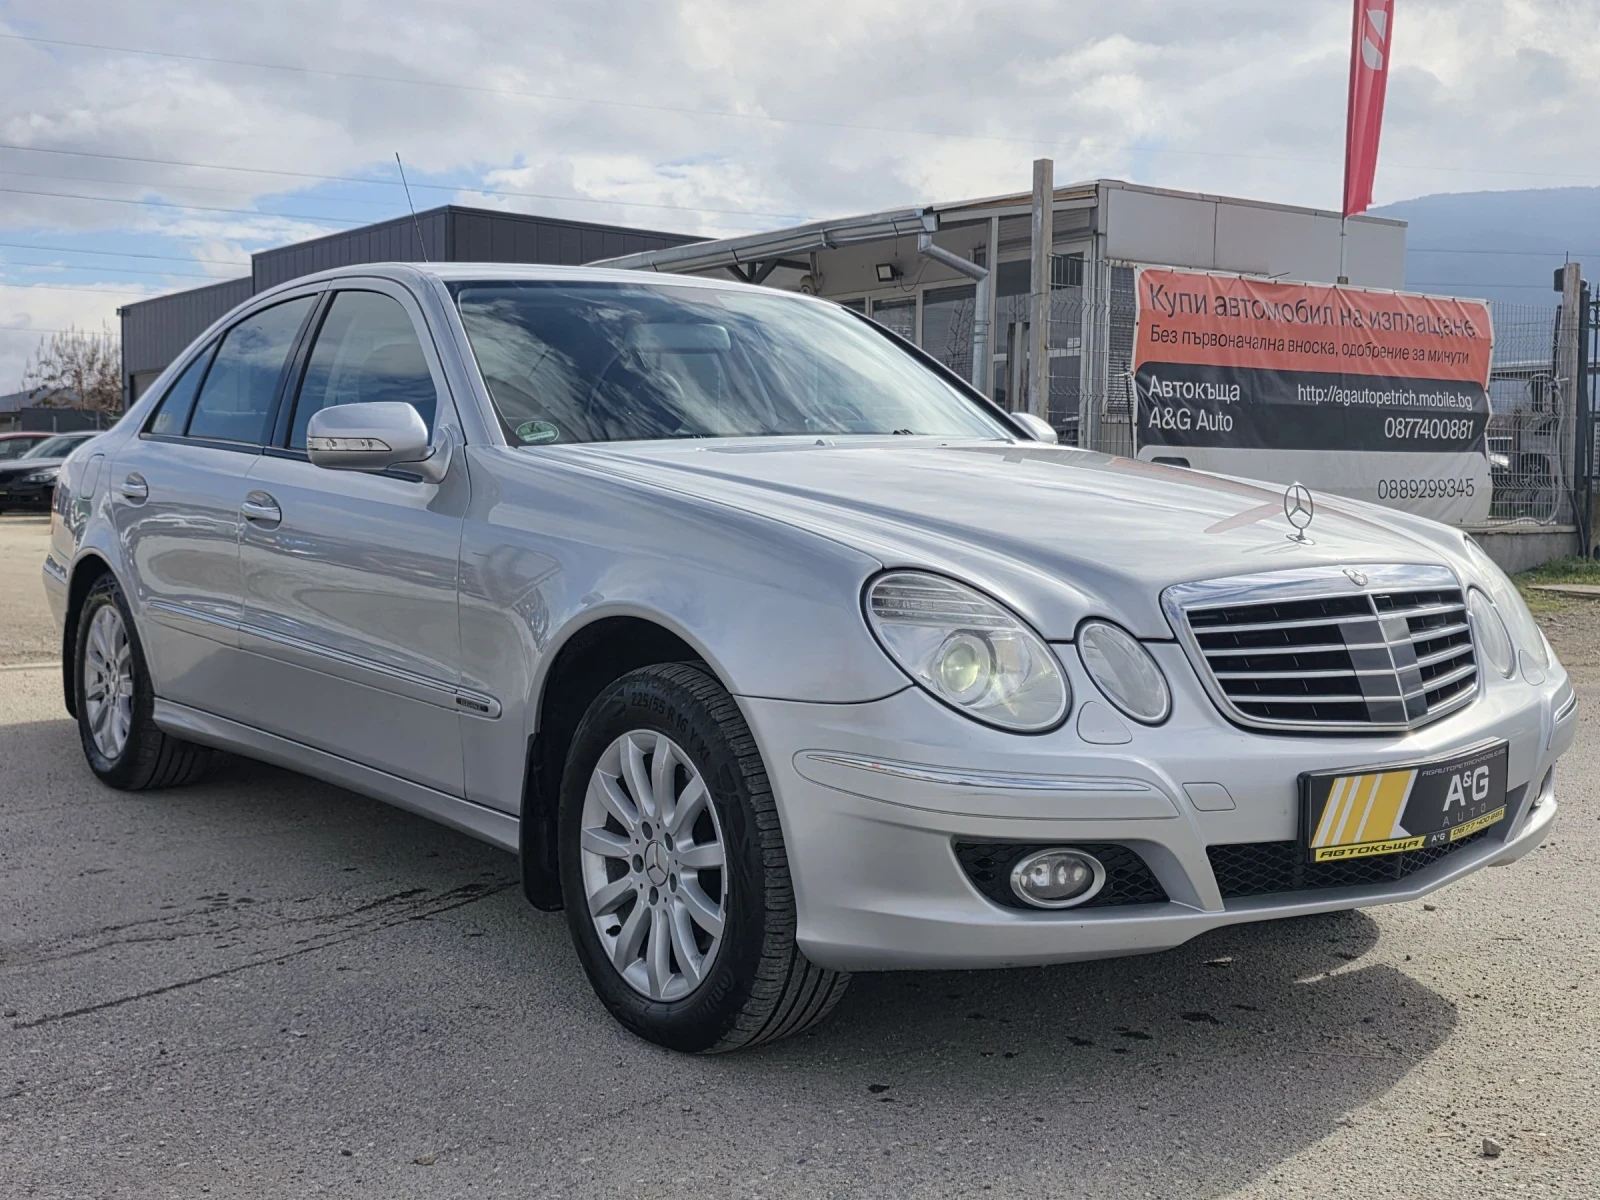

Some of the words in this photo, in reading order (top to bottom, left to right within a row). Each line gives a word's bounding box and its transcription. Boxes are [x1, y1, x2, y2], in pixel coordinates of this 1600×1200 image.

[1149, 283, 1208, 318] Купи
[1214, 295, 1334, 326] автомобил
[1340, 307, 1364, 329] на
[1370, 311, 1476, 339] изплащане
[1151, 324, 1178, 344] Без
[1182, 331, 1285, 352] първоначална
[1288, 339, 1339, 357] вноска,
[1342, 341, 1409, 361] одобрение
[1412, 349, 1425, 361] за
[1427, 350, 1469, 367] минути
[1148, 374, 1241, 402] Автокъща
[1297, 384, 1473, 411] http://agautopetrich.mobile.bg
[1148, 408, 1191, 431] A&G
[1196, 409, 1234, 432] Auto
[1384, 417, 1474, 440] 0877400881
[1377, 478, 1475, 499] 0889299345
[631, 691, 665, 715] 225/55
[676, 713, 689, 732] 16
[1442, 765, 1489, 812] A&G
[1442, 802, 1486, 827] AUTO
[1319, 840, 1419, 859] АВТОКЪЩА
